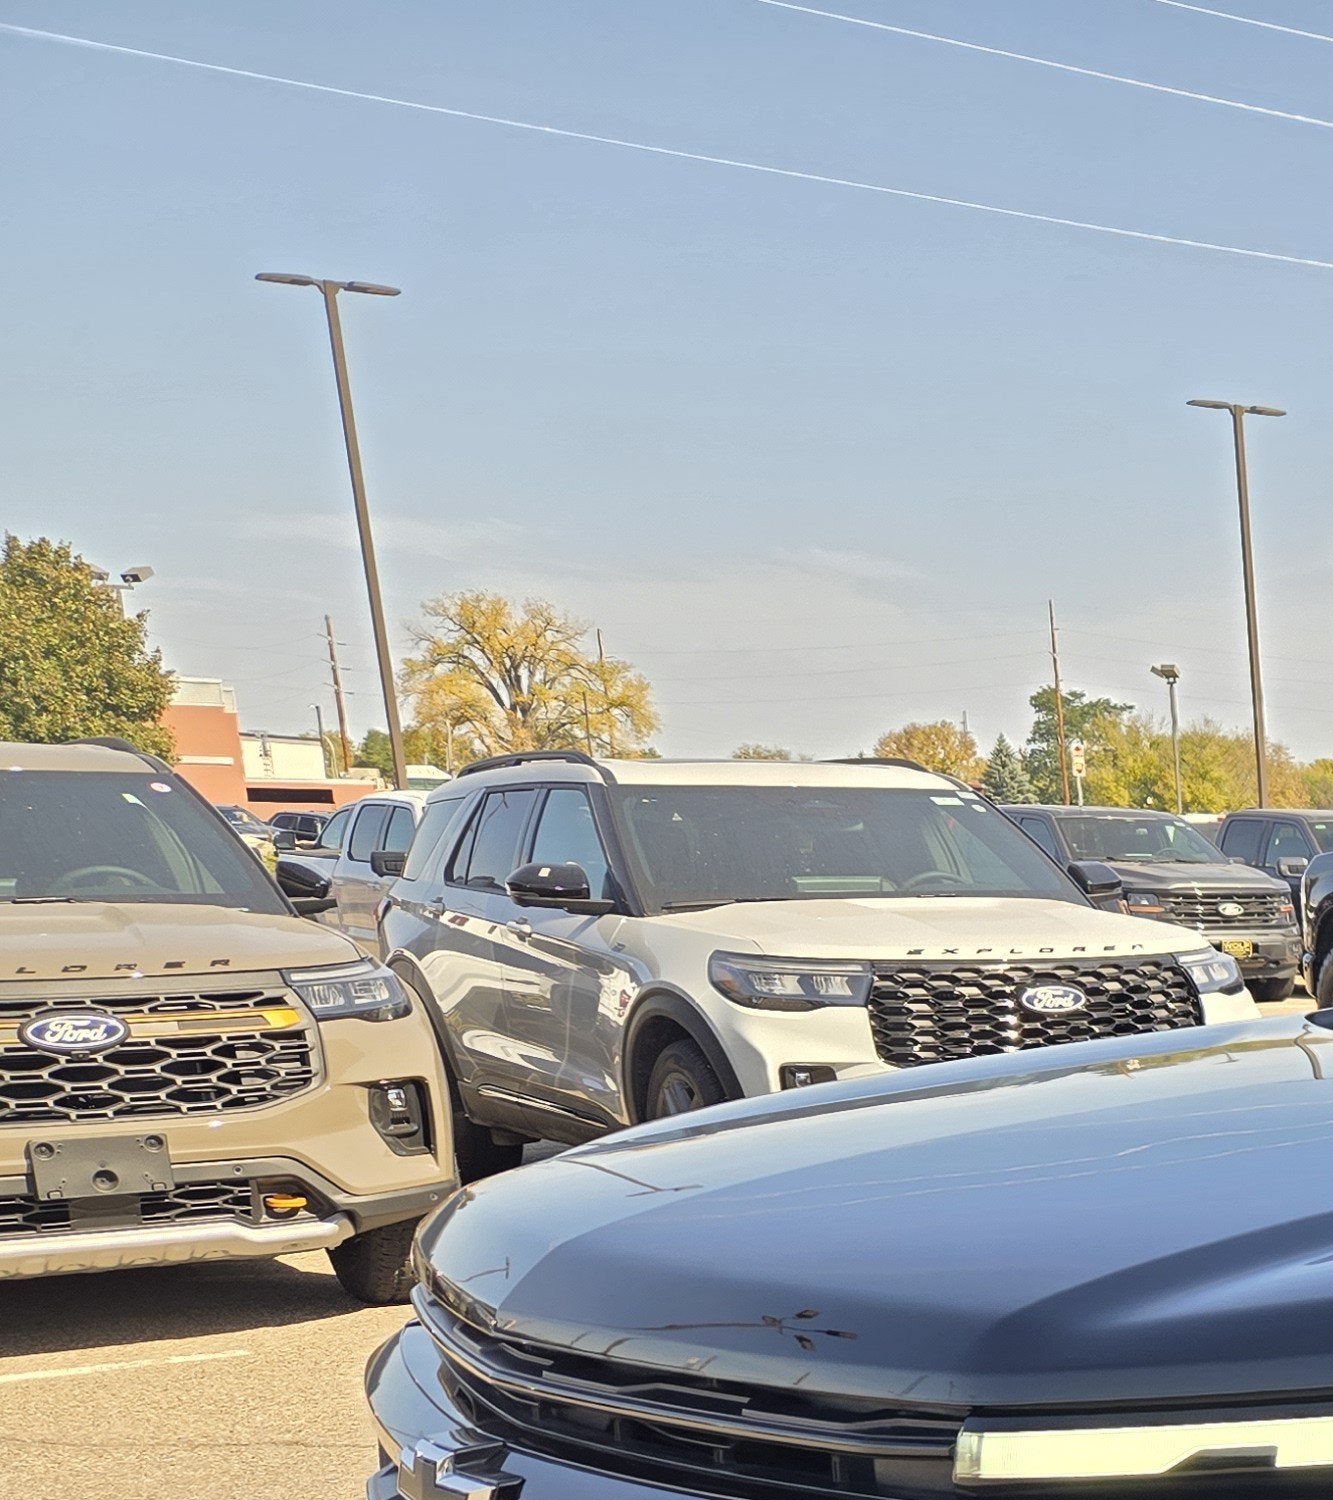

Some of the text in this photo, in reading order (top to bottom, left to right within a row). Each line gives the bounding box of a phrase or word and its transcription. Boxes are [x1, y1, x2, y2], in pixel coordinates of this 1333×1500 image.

[906, 943, 1144, 956] EXPLORER
[1034, 986, 1076, 1009] Ford
[44, 1018, 107, 1043] Ford
